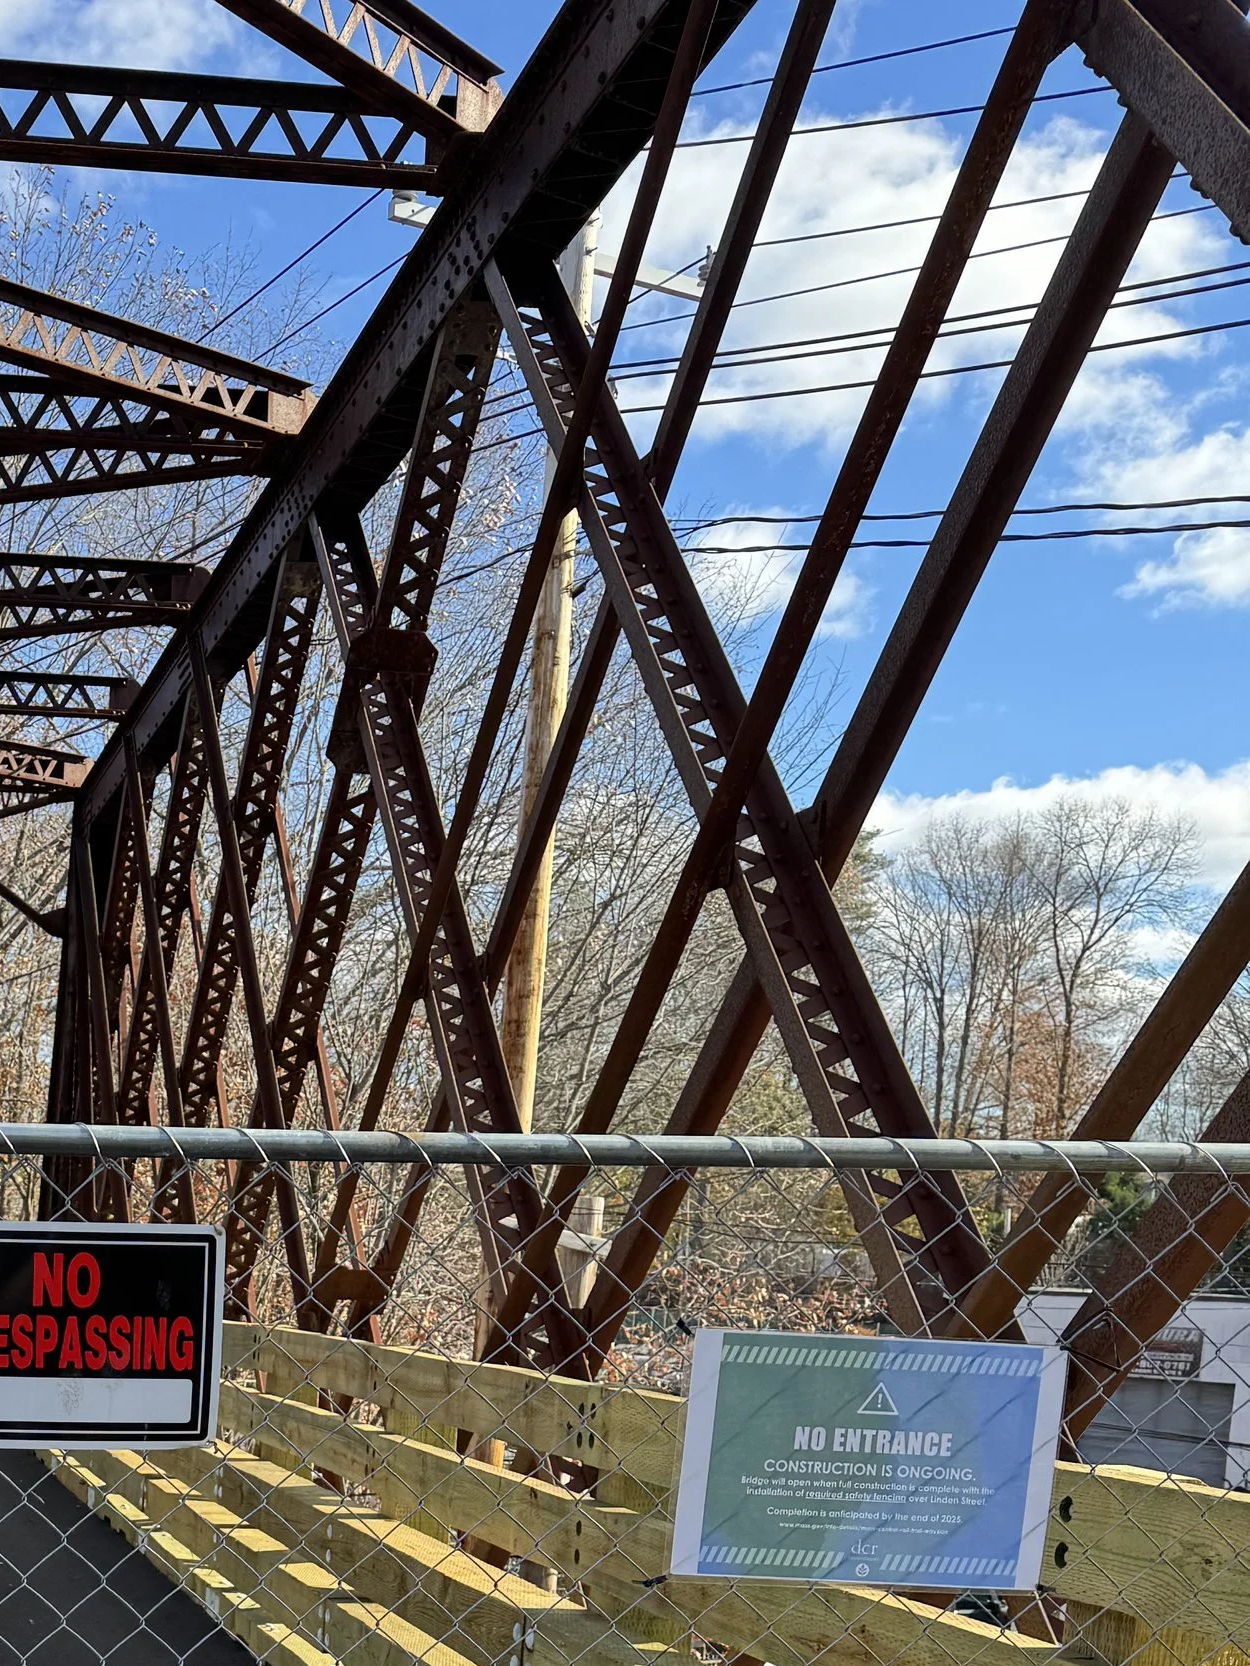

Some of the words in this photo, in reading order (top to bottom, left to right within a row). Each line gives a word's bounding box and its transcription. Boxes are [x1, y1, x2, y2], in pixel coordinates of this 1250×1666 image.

[32, 1252, 101, 1309] NO
[793, 1426, 827, 1453] NO
[832, 1428, 953, 1457] ENTRANCE
[764, 1459, 877, 1476] CONSTRUCTION
[881, 1464, 892, 1477] IS
[897, 1465, 976, 1481] ONGOING.
[741, 1476, 769, 1486] Bridge
[771, 1477, 786, 1486] will
[787, 1479, 810, 1488] open
[813, 1479, 837, 1488] when
[838, 1480, 852, 1489] full
[854, 1482, 907, 1491] construction
[909, 1483, 915, 1491] is
[918, 1484, 960, 1494] complete
[962, 1486, 980, 1495] with
[981, 1487, 996, 1496] the
[746, 1487, 794, 1497] installation
[795, 1489, 804, 1497] of
[806, 1490, 843, 1500] required
[845, 1491, 871, 1501] safety
[873, 1493, 906, 1503] fencing
[930, 1495, 959, 1505] Linden
[766, 1507, 818, 1517] Completion
[820, 1508, 826, 1517] is
[829, 1510, 879, 1520] anticipated
[882, 1512, 893, 1522] by
[895, 1513, 909, 1521] the
[911, 1514, 928, 1522] end
[931, 1514, 939, 1522] of
[941, 1515, 963, 1523] 2025.
[850, 1539, 878, 1555] dcr
